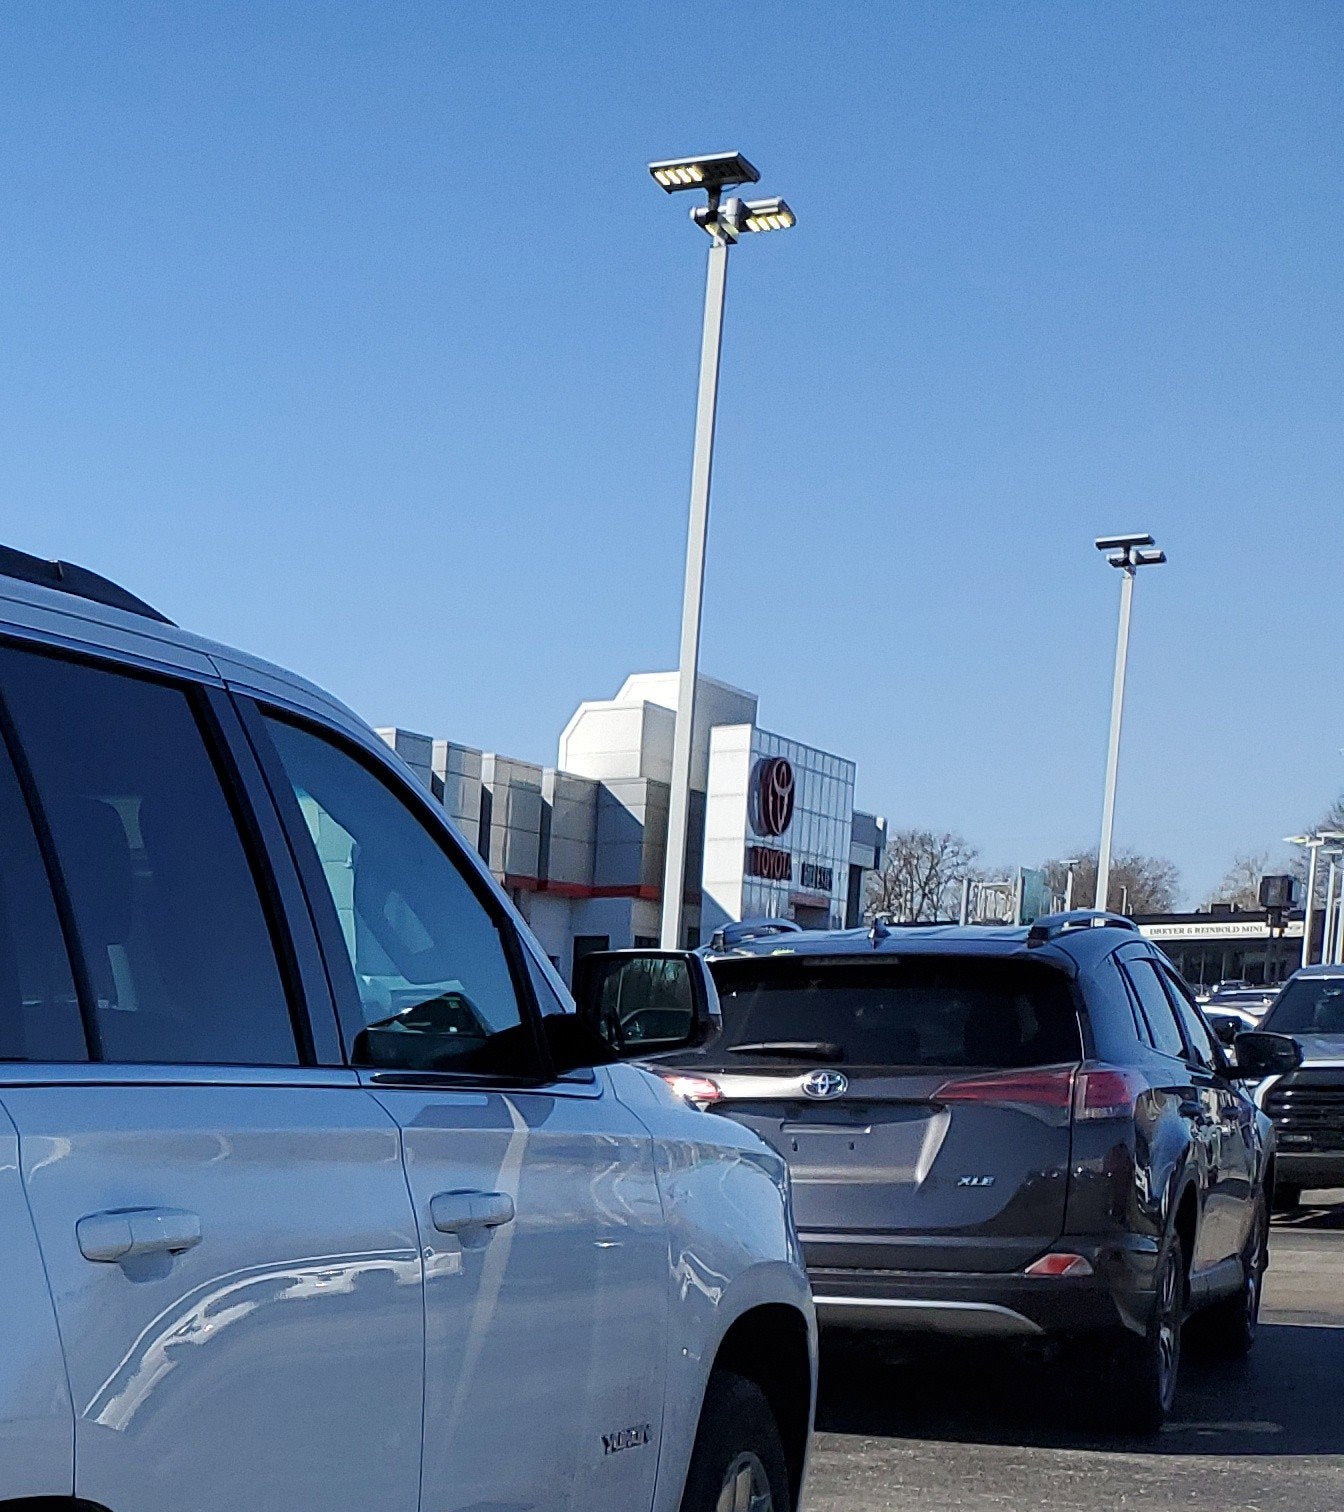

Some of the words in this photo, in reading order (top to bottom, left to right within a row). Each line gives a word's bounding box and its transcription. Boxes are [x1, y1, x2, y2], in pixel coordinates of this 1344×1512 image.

[757, 847, 791, 880] TOYOTA
[1241, 925, 1264, 934] MINI
[957, 1175, 995, 1187] XLE
